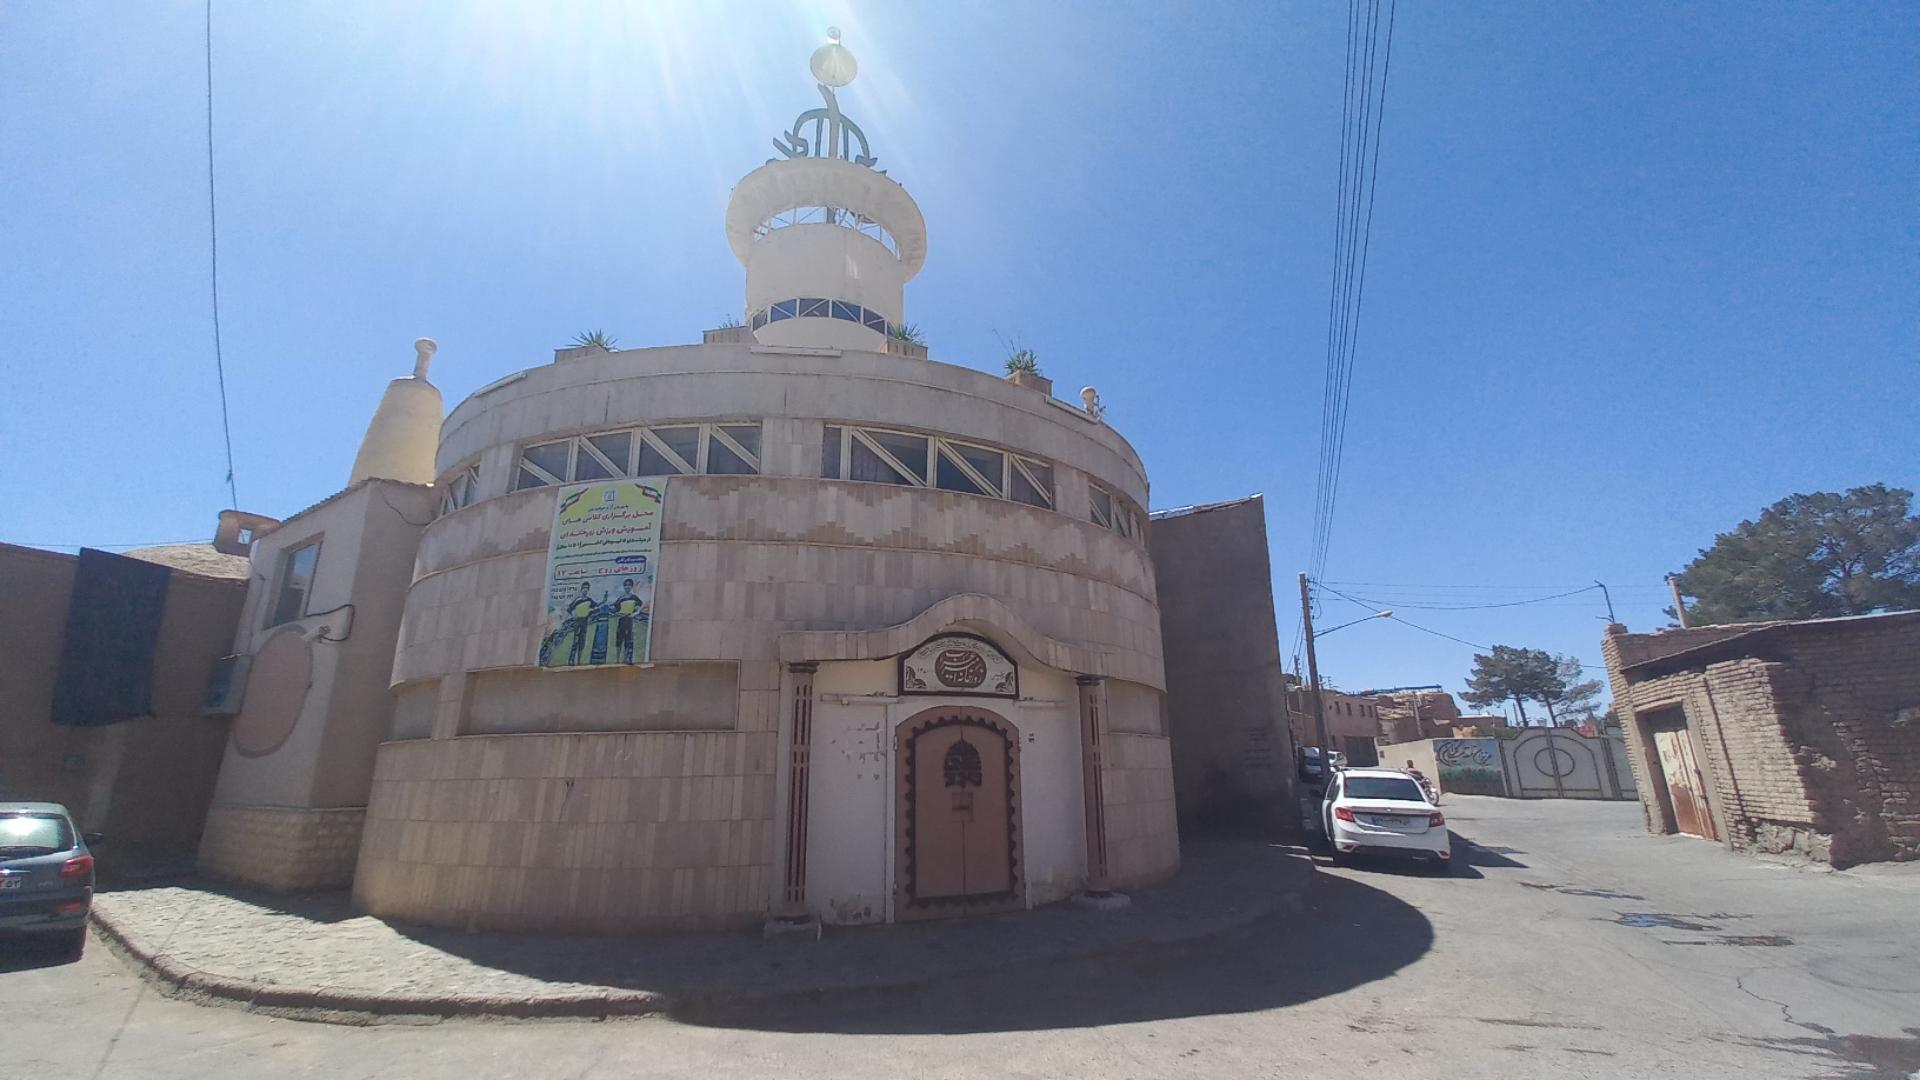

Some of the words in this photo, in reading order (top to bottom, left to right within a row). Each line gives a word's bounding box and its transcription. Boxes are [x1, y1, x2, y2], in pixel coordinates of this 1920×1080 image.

[582, 512, 602, 524] کلاس
[602, 510, 631, 521] برگزاری
[633, 511, 654, 519] محل
[595, 526, 615, 536] ورزش
[616, 522, 652, 534] آموزش
